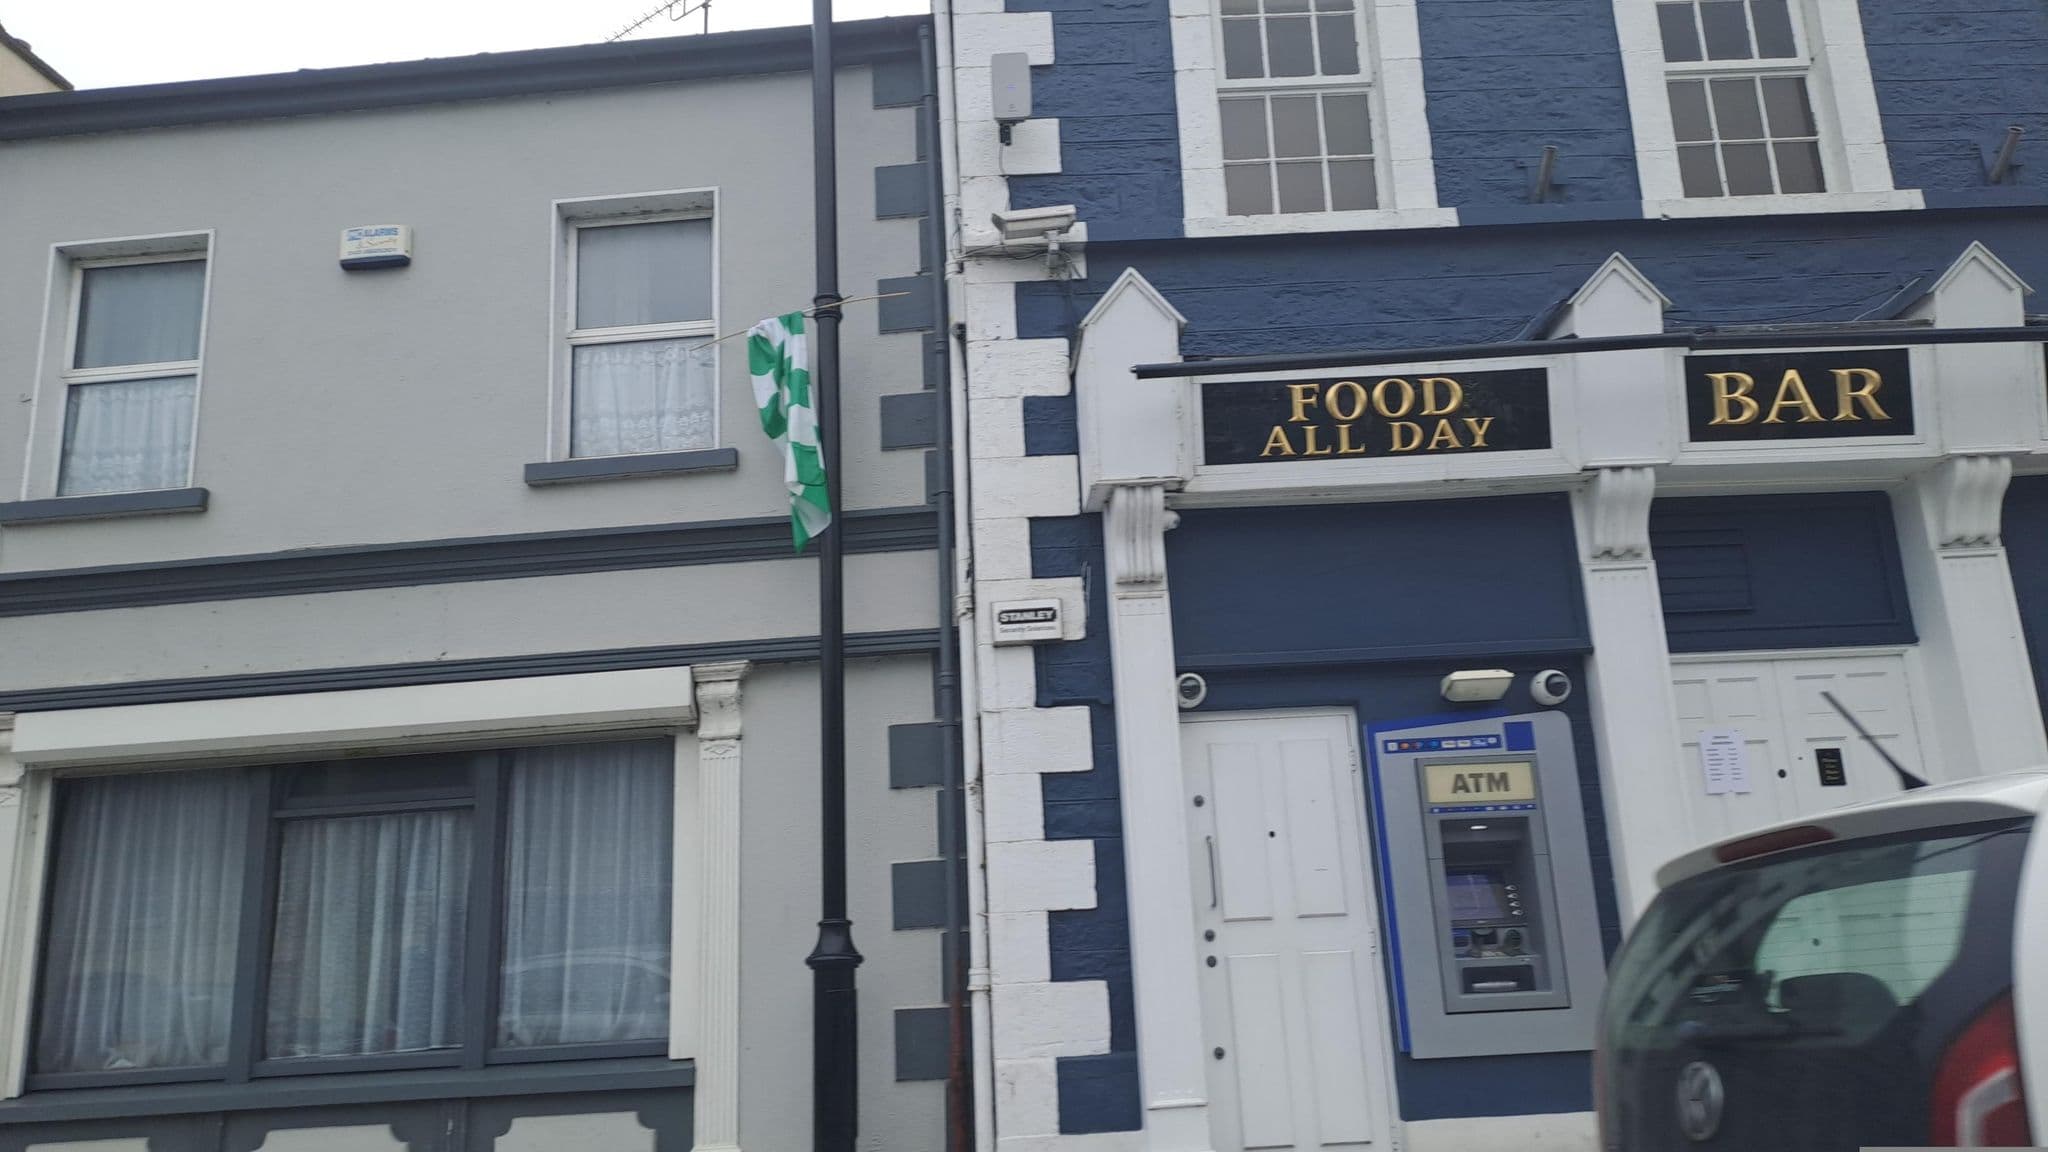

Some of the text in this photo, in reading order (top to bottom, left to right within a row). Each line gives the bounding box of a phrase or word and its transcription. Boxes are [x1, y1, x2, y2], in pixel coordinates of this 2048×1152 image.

[1286, 377, 1463, 421] FOOD
[1704, 368, 1892, 425] BAR
[1259, 417, 1496, 457] ALL DAY
[1000, 610, 1054, 622] STANLEY
[1451, 772, 1511, 794] ATM
